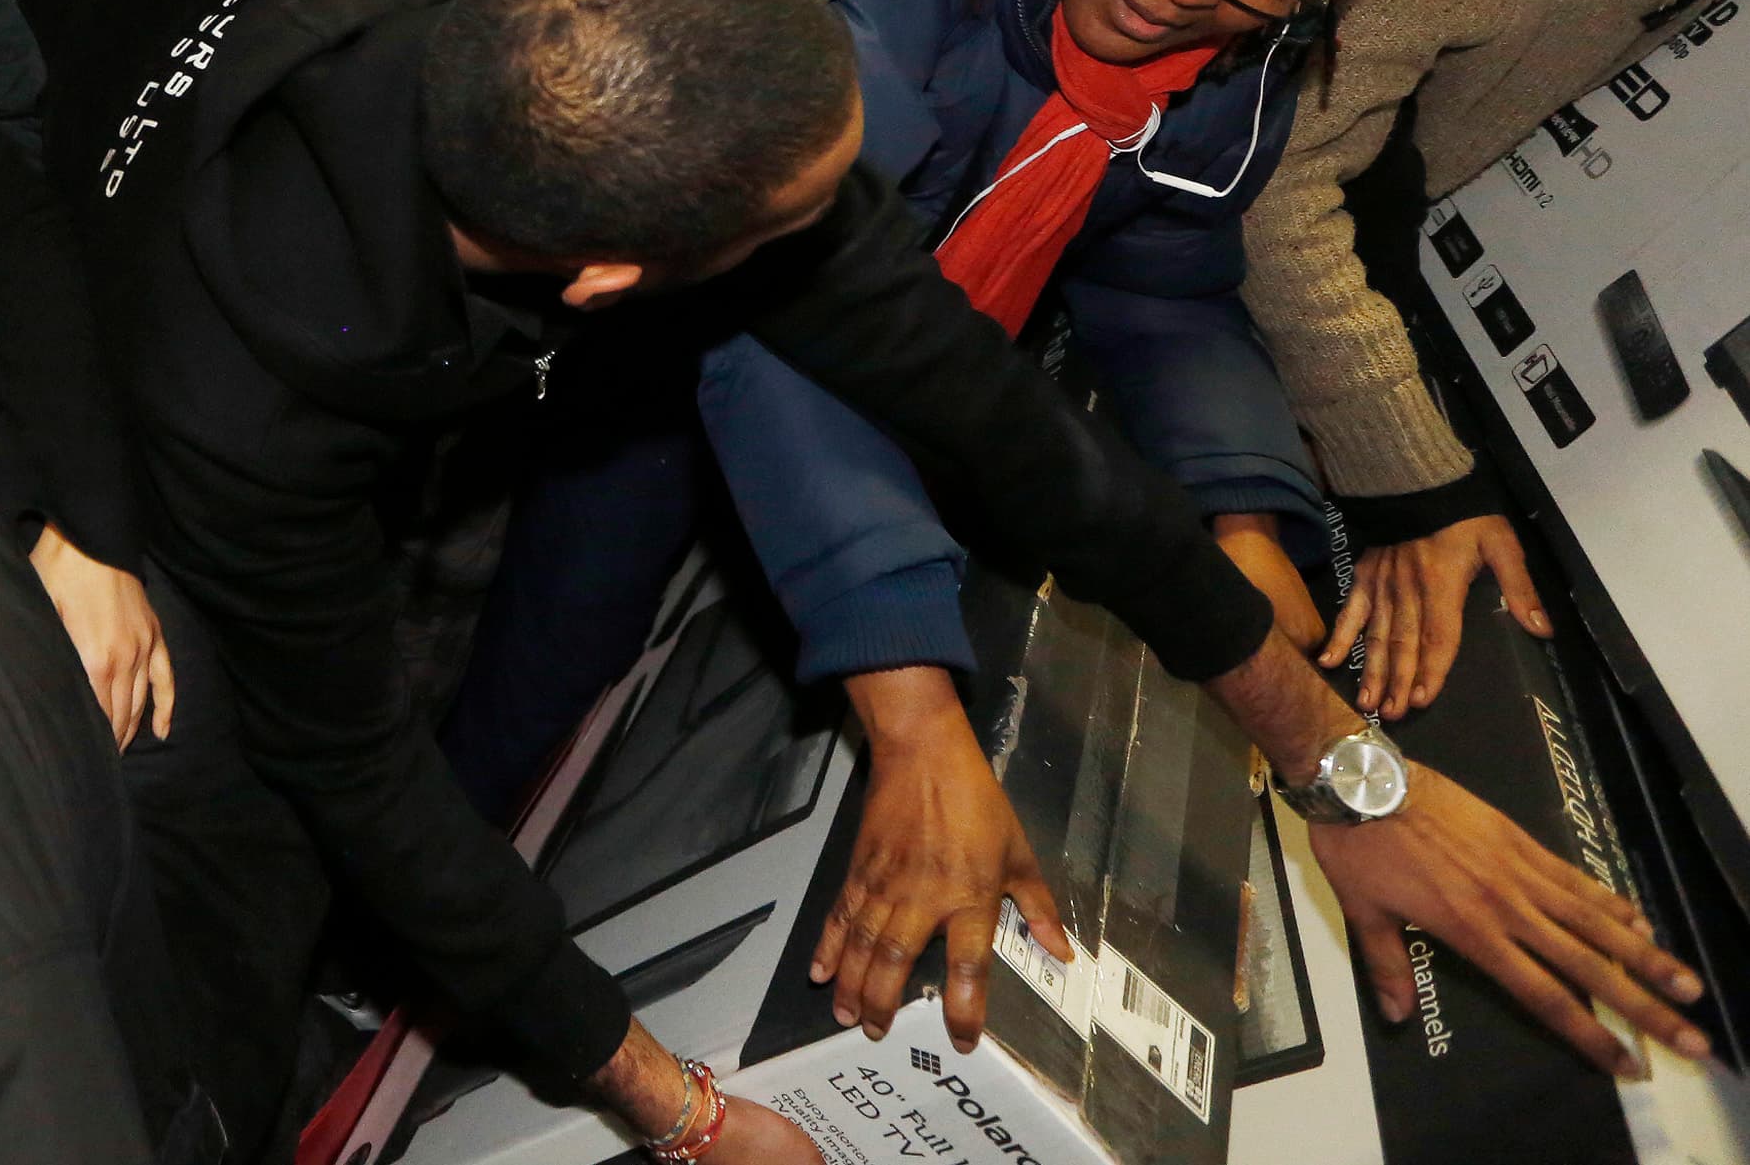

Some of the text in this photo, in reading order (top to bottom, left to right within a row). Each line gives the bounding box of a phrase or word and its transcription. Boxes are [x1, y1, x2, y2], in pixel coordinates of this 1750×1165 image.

[105, 117, 159, 199] LTD
[1569, 136, 1613, 180] HD
[1330, 523, 1350, 553] HD
[1533, 694, 1618, 895] ull HD LED TV
[1408, 940, 1453, 1058] channels
[769, 1095, 791, 1114] TV
[780, 1092, 824, 1134] quality
[793, 1087, 830, 1124] Enjoy
[827, 1071, 926, 1159] LED TV
[856, 1065, 954, 1157] 40" Full
